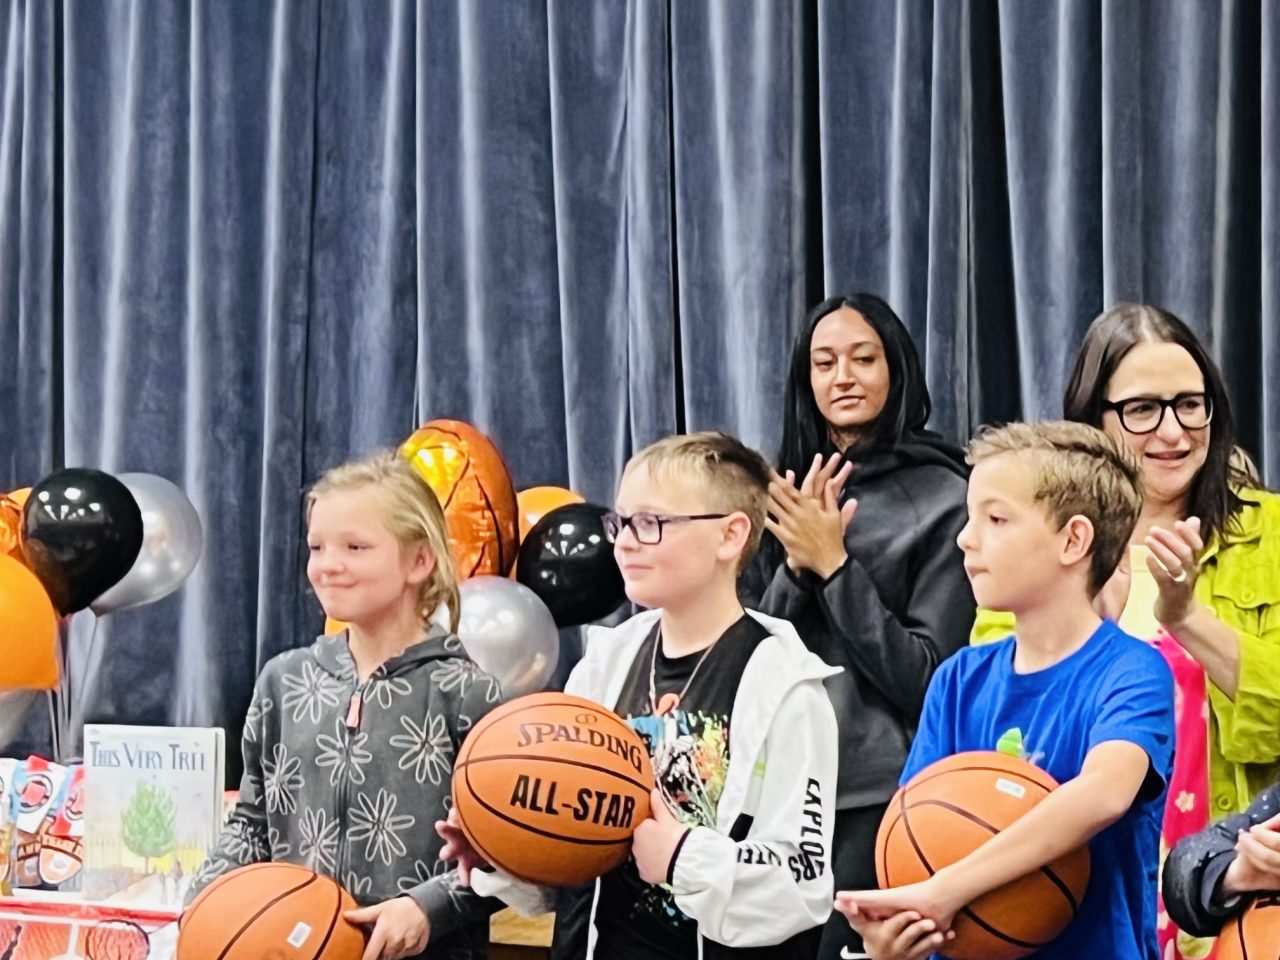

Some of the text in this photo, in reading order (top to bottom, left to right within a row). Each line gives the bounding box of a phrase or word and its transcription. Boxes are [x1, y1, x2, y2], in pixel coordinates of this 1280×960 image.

[89, 740, 121, 768] THIS
[122, 742, 163, 770] VERY
[517, 722, 642, 775] SPALDING
[510, 773, 636, 829] ALL-STAR
